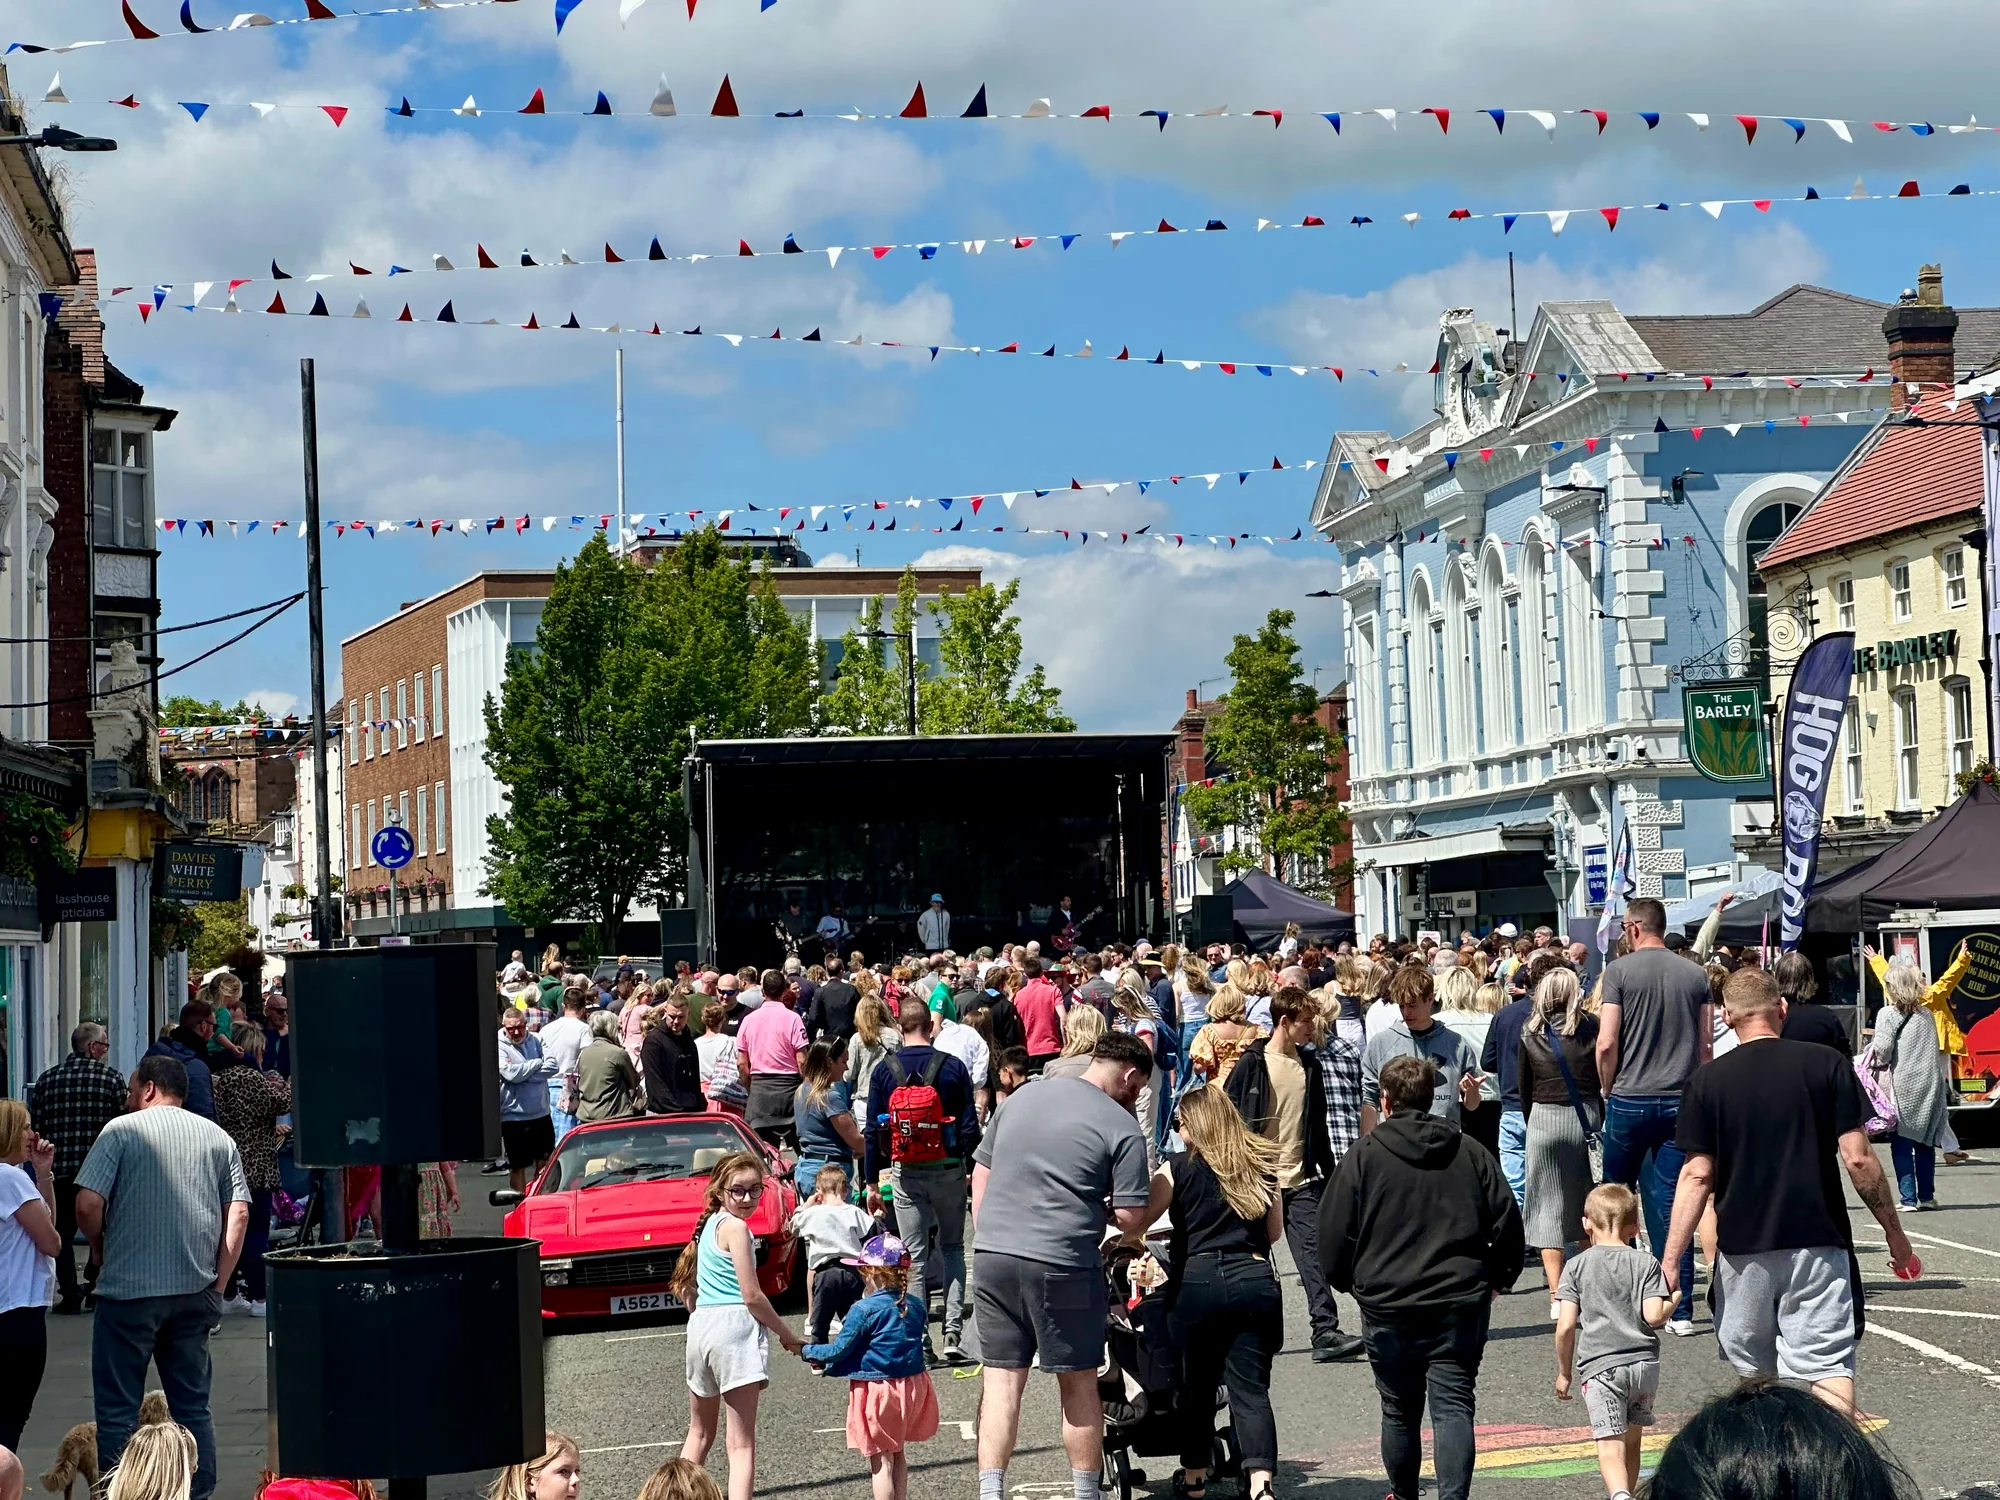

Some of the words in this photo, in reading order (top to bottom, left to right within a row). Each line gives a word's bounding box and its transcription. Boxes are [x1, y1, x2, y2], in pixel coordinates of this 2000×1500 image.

[1853, 647, 1874, 674] HE
[1877, 629, 1957, 671] BARLEY
[1713, 694, 1732, 703] THE
[1695, 704, 1751, 719] BARLEY
[1789, 691, 1843, 792] HOG
[172, 851, 216, 864] DAVIES
[171, 864, 215, 876] WHITE
[55, 894, 110, 904] lasshouse
[1781, 845, 1809, 953] ROA
[61, 907, 105, 919] pticians
[1976, 939, 1999, 953] EVENT
[1968, 966, 1978, 975] OG
[1978, 969, 2000, 984] ROAST
[1968, 980, 1987, 993] HIRE
[618, 1295, 659, 1311] A562
